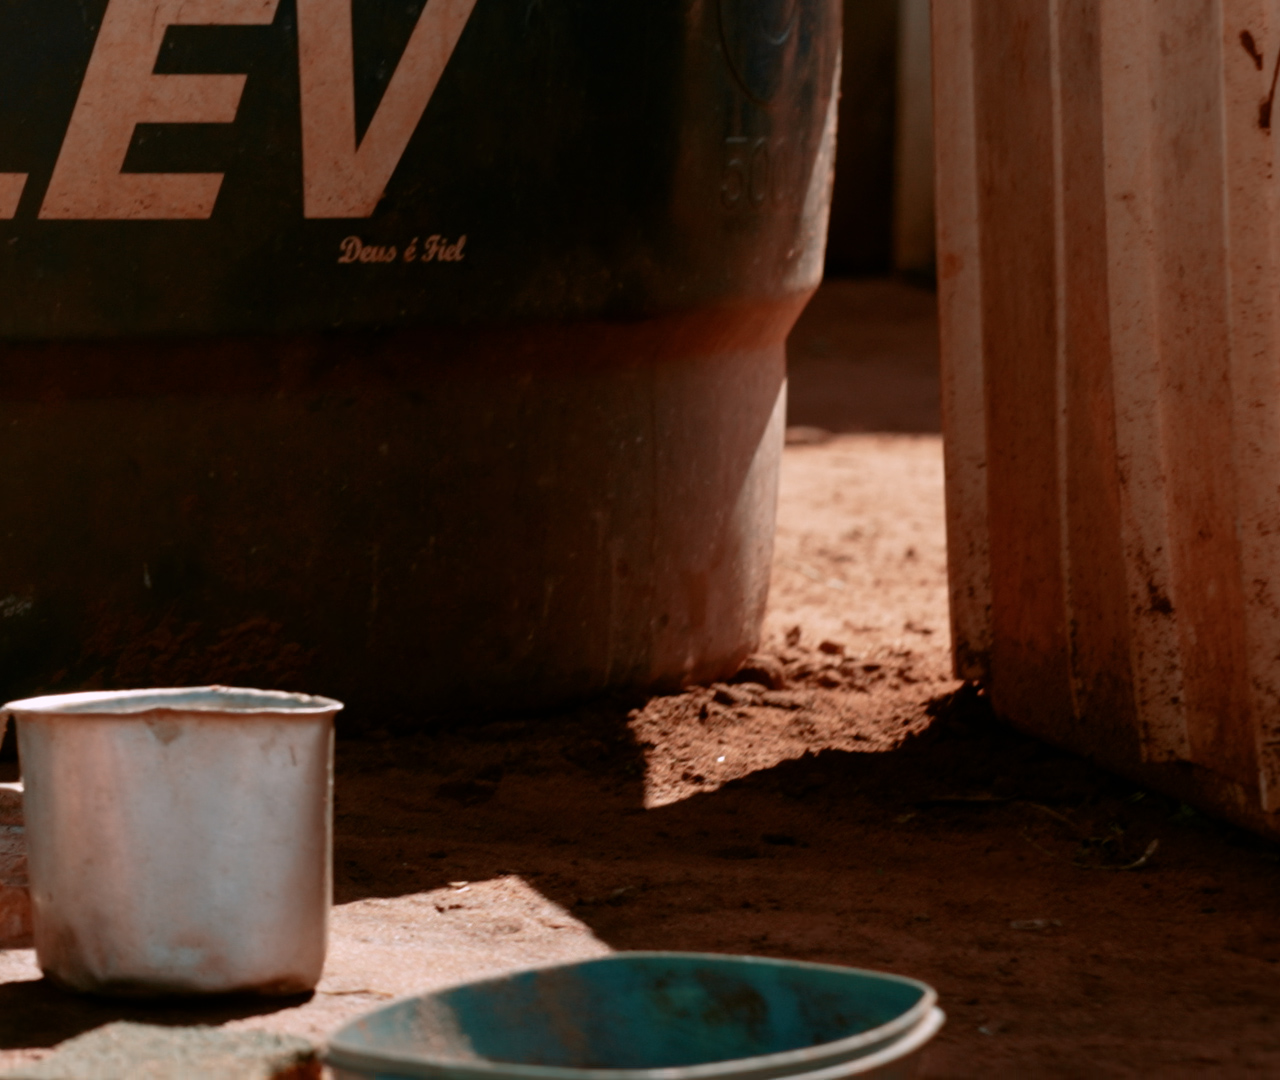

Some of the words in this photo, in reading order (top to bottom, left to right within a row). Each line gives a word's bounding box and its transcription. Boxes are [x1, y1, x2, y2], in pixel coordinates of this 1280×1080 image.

[338, 235, 397, 264] Deus
[403, 236, 419, 263] é
[421, 234, 468, 263] Fiel
